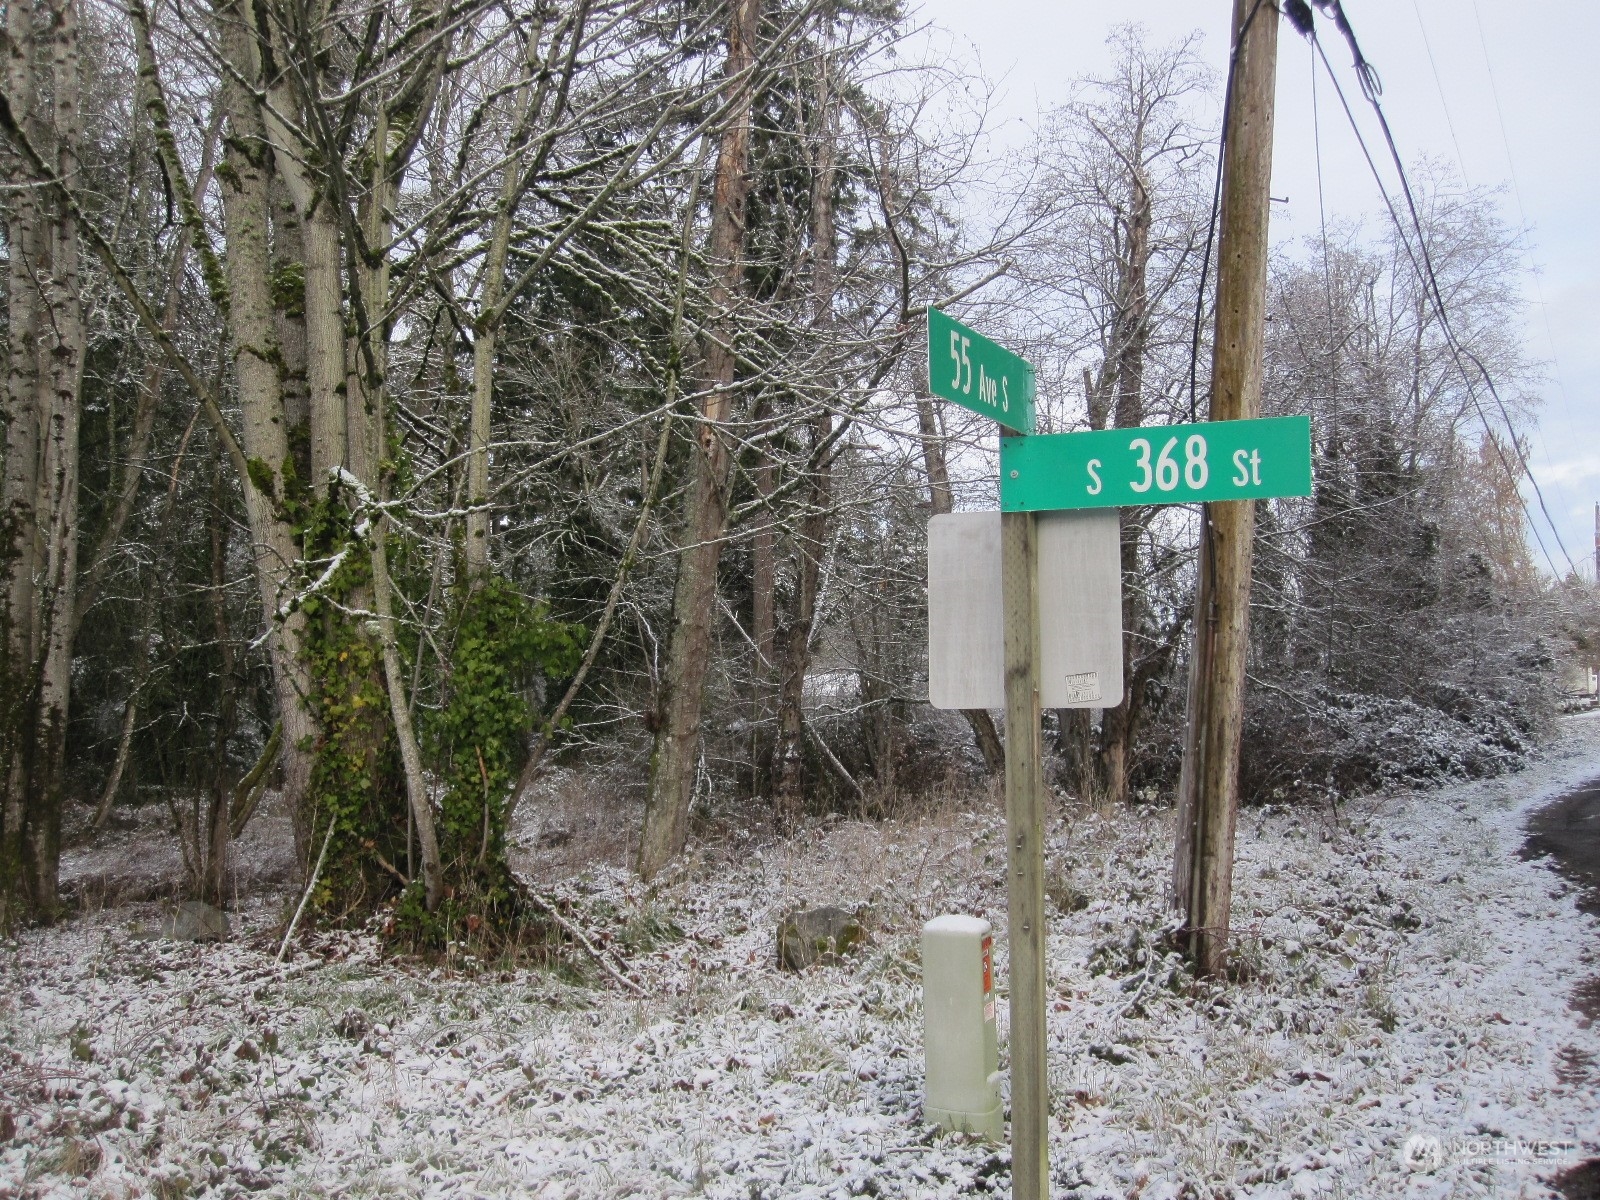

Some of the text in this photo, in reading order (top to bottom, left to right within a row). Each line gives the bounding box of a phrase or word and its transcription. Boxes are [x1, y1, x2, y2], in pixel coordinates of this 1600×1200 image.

[950, 329, 1009, 413] 55 Ave S
[1086, 434, 1262, 495] S 368 St
